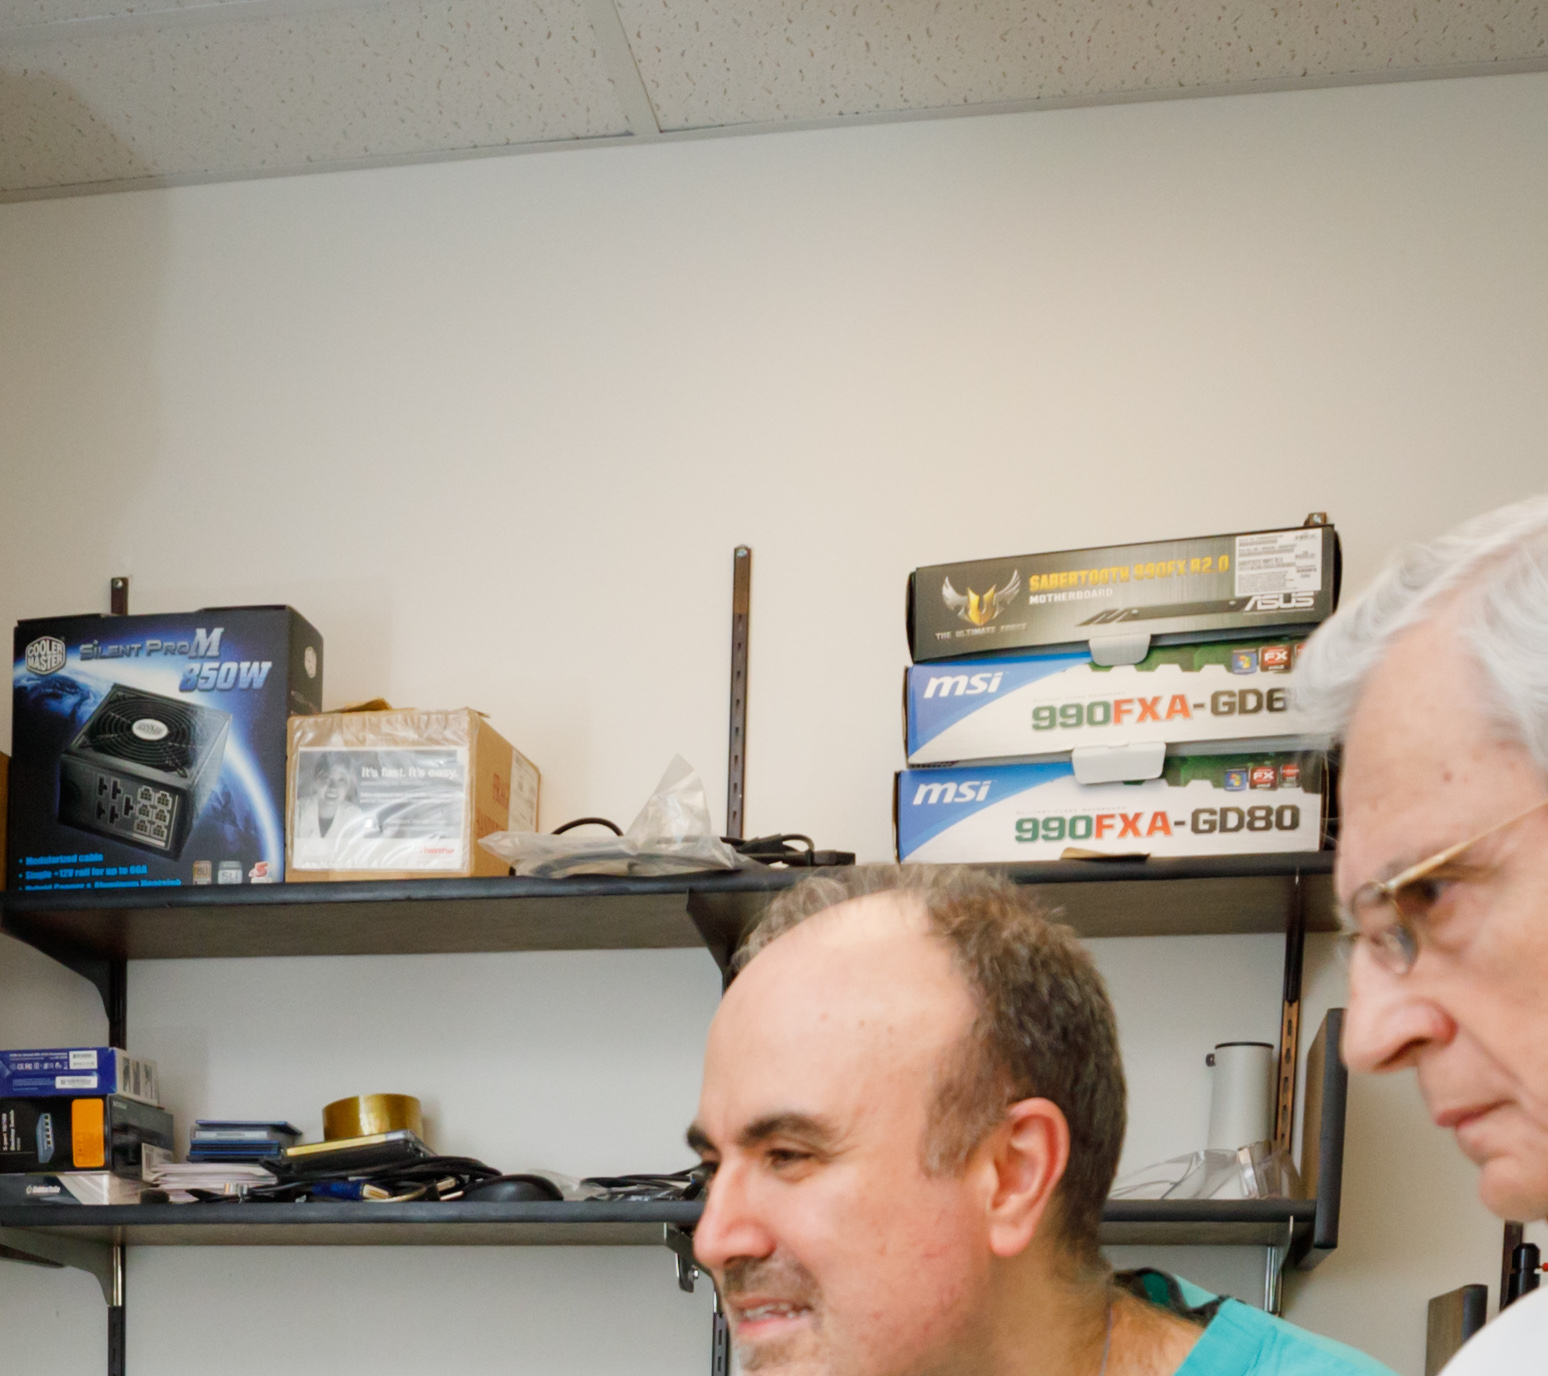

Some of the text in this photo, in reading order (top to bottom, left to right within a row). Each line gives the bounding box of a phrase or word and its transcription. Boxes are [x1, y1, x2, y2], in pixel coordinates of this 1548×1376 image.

[1029, 565, 1130, 592] SABERTOOTH
[1134, 559, 1186, 581] 990FX
[1029, 588, 1113, 605] MOTHERBOARD
[1244, 592, 1315, 611] ASUS
[28, 640, 63, 656] COOLER
[1265, 651, 1287, 662] FX
[27, 654, 63, 671] MASTER
[179, 661, 272, 692] 850W
[924, 671, 1003, 699] msi
[912, 779, 992, 806] msi
[1014, 804, 1301, 843] 990FXA-GD80
[26, 853, 104, 865] Modularized cable
